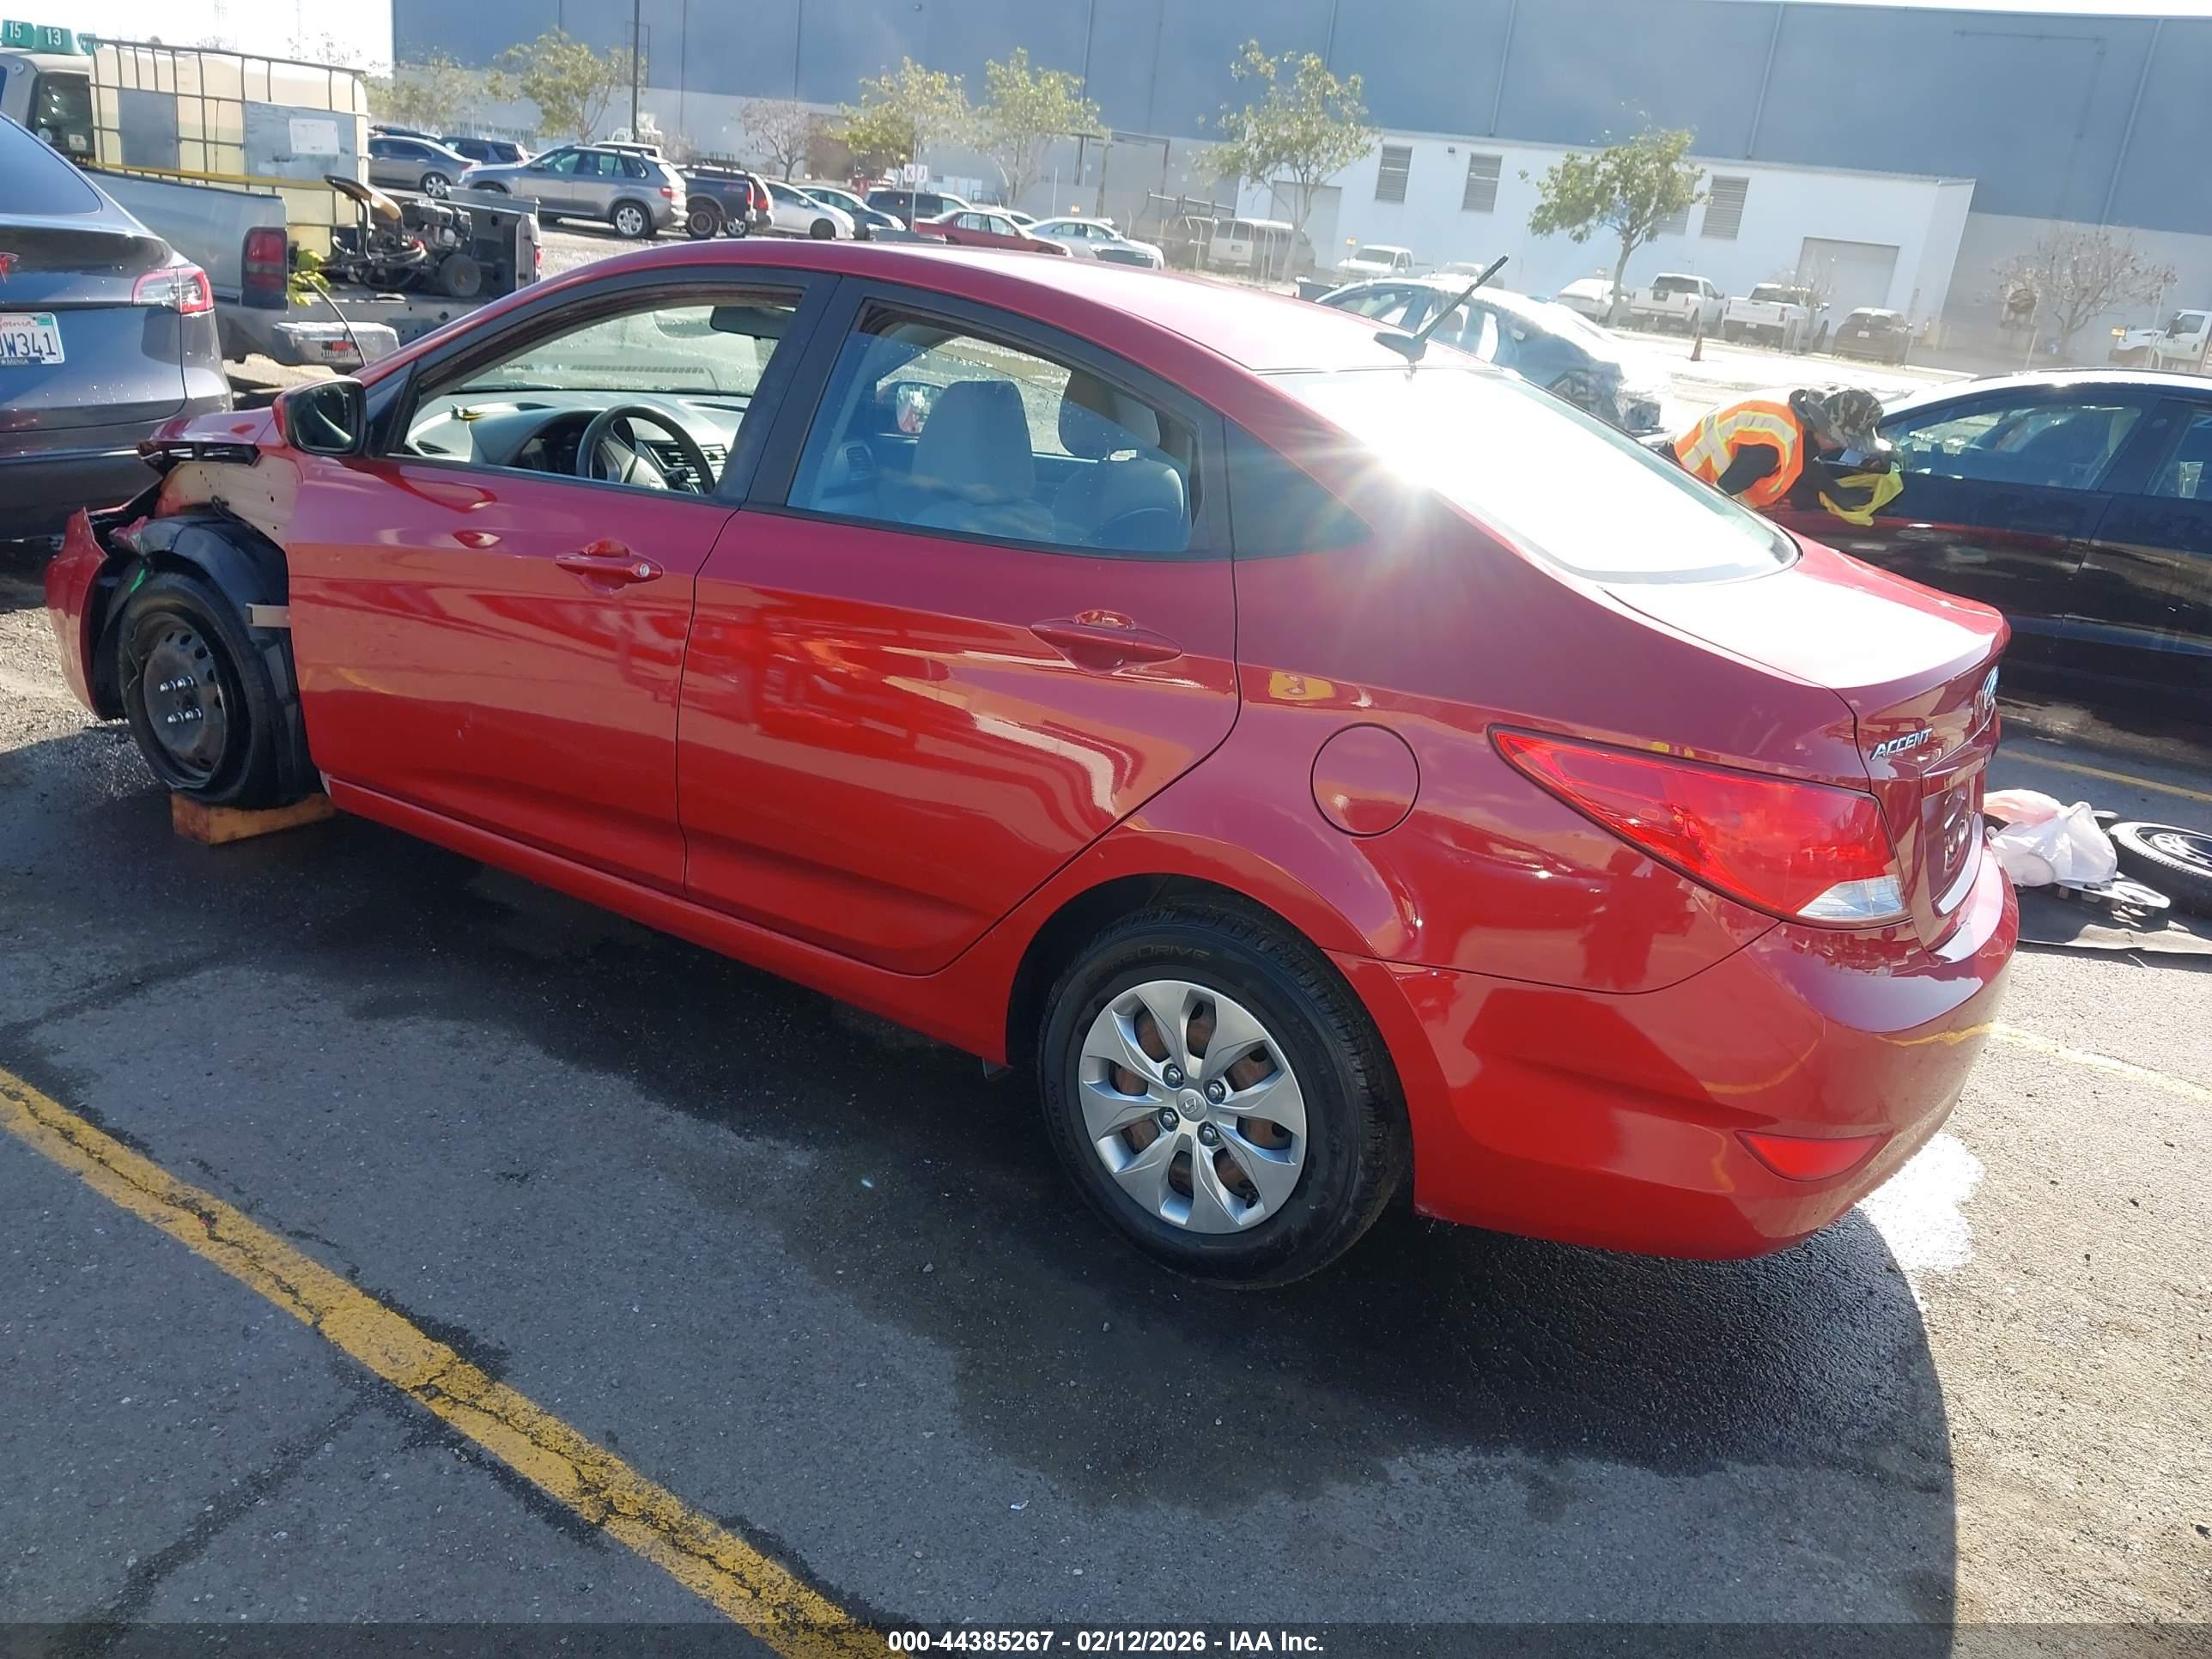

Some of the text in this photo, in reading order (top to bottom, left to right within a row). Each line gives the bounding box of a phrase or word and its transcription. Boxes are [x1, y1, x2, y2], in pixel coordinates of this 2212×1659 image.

[9, 21, 22, 39] 15
[46, 27, 62, 46] 13
[906, 167, 914, 179] K
[1869, 728, 1933, 761] ACCENT
